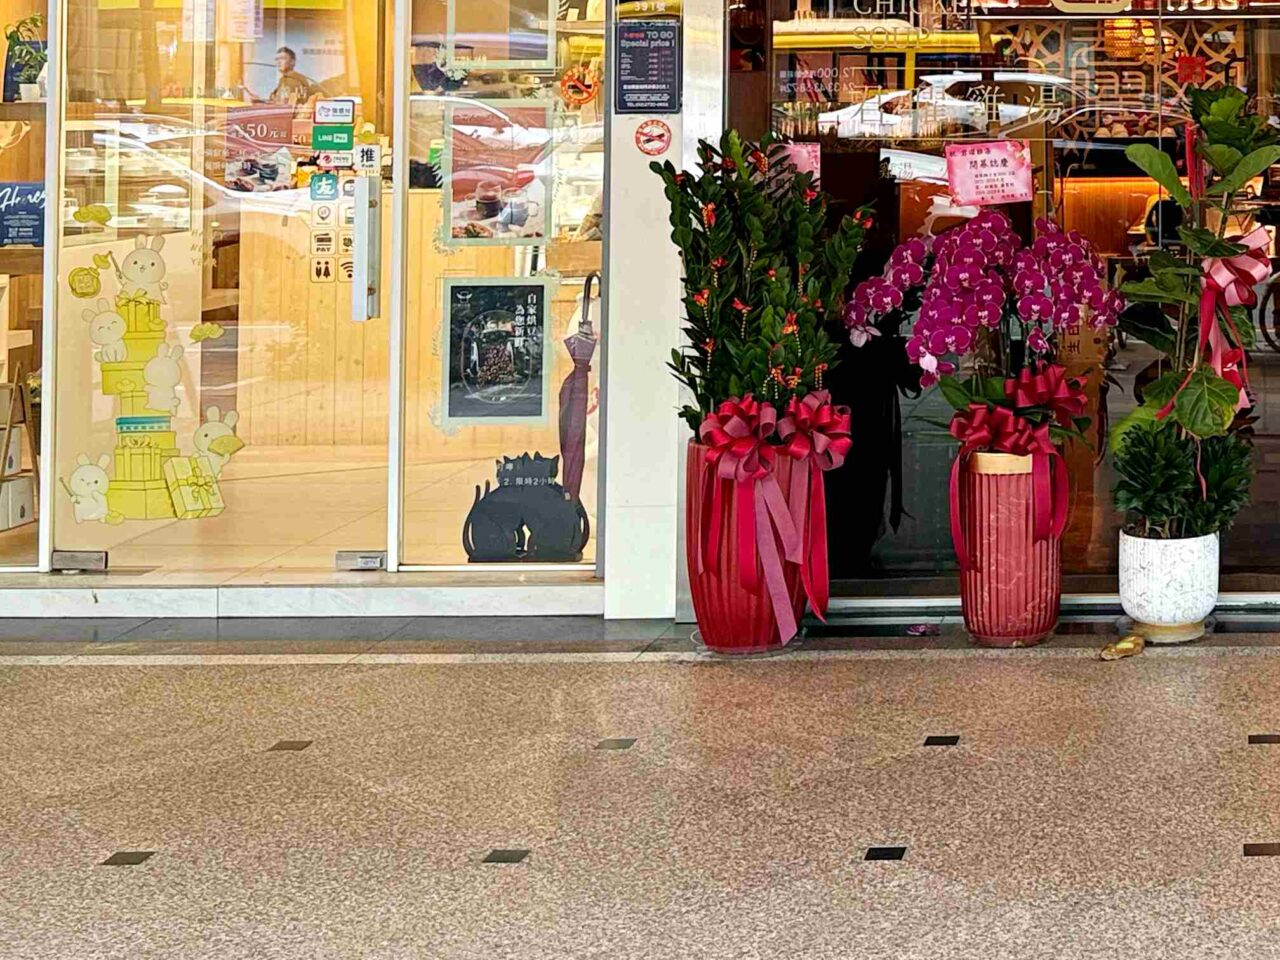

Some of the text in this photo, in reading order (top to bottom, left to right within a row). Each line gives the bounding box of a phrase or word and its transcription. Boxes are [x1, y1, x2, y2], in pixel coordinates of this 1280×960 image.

[647, 31, 659, 39] TO
[660, 31, 674, 39] GO
[852, 25, 932, 50] SOUP
[317, 134, 333, 142] LINE
[361, 147, 376, 163] 推
